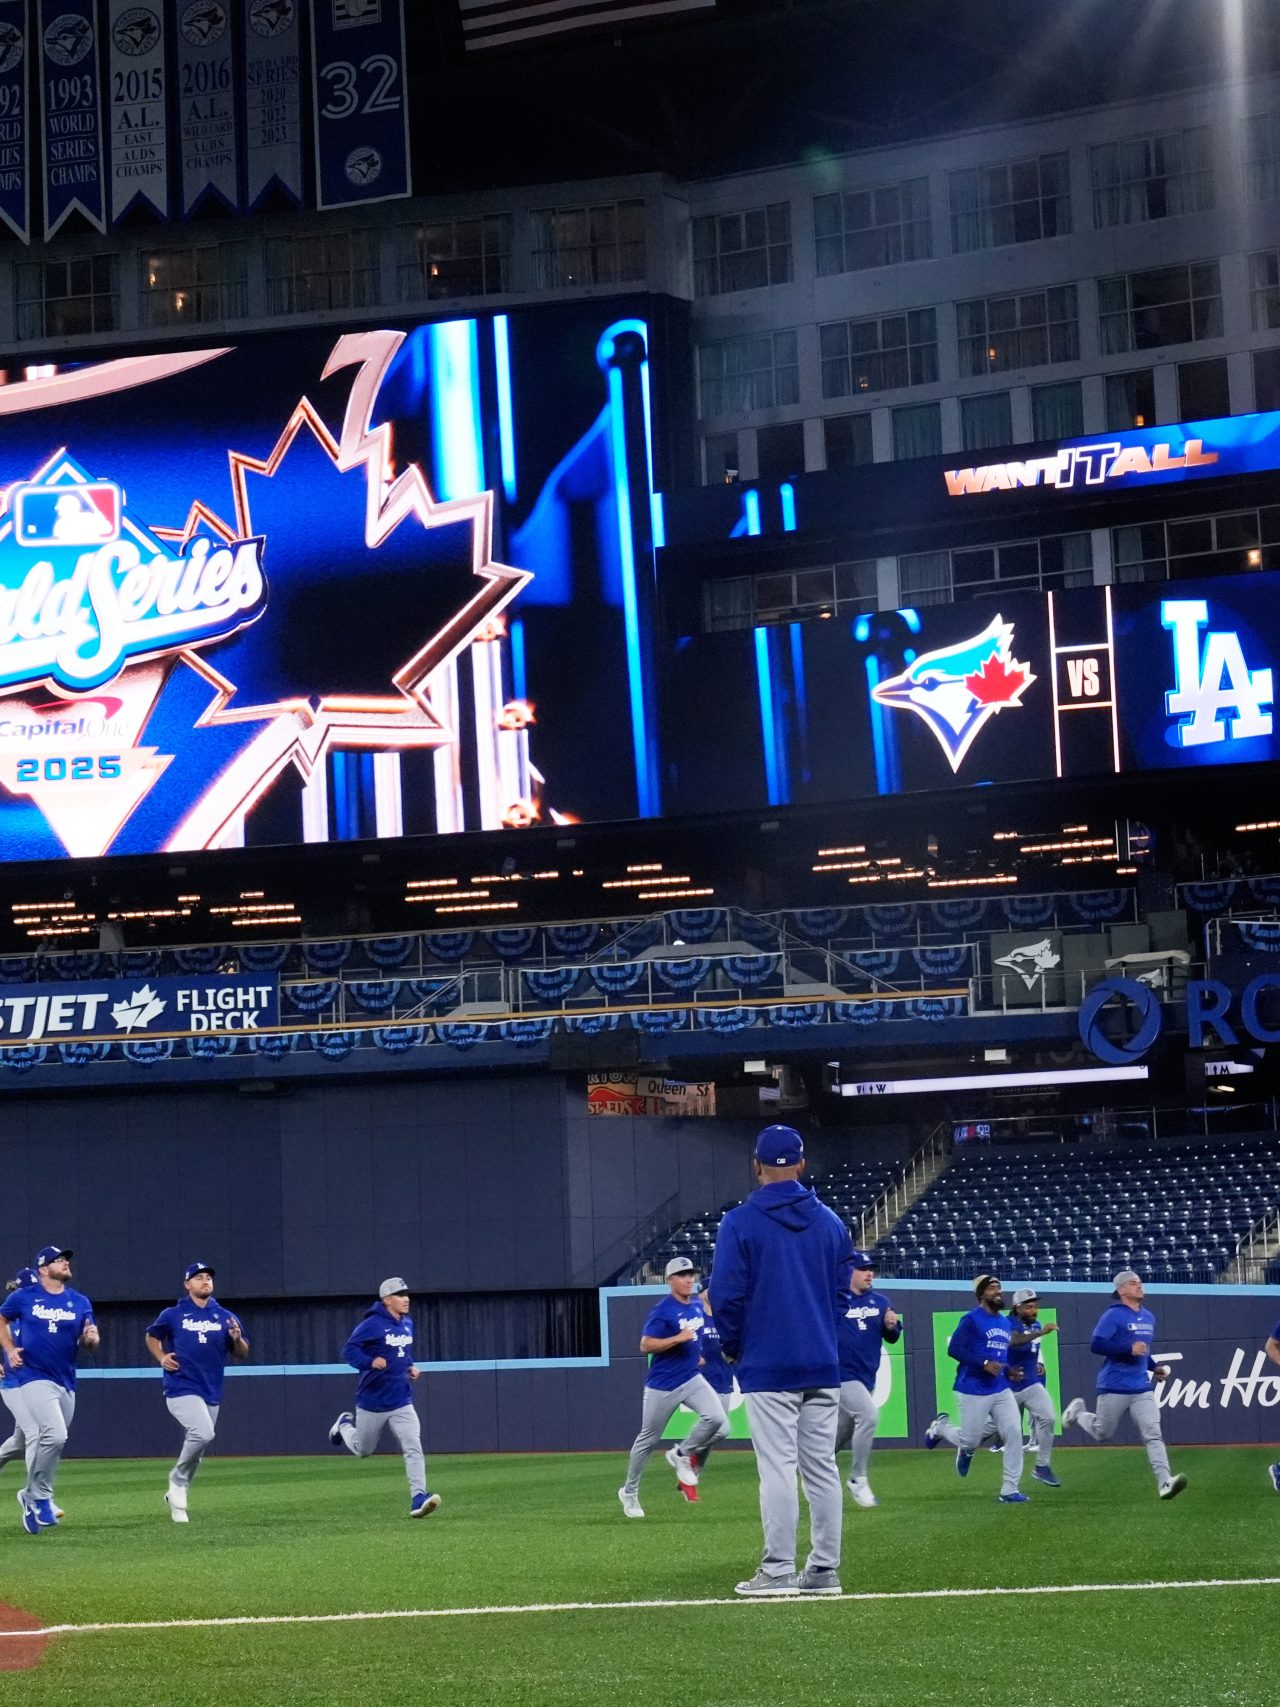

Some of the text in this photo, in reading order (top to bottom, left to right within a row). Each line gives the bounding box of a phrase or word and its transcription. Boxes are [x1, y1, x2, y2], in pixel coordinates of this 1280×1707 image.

[114, 68, 162, 102] 2015
[182, 57, 230, 94] 2016
[248, 66, 298, 86] SERIES
[320, 54, 401, 119] 32
[48, 74, 92, 111] 1993
[118, 107, 160, 129] A.L.
[188, 99, 228, 121] A.L.
[49, 113, 95, 135] WORLD
[124, 132, 153, 145] EAST
[50, 140, 95, 161] SERIES
[186, 154, 233, 169] CHAMPS
[50, 164, 98, 186] CHAMPS
[116, 163, 163, 178] CHAMPS
[944, 456, 1060, 496] WANT
[1106, 439, 1218, 477] ALL
[56, 540, 263, 678] Series
[1066, 658, 1100, 697] VS
[1161, 600, 1274, 748] LA
[16, 755, 122, 783] 2025
[177, 986, 273, 1012] FLIGHT
[190, 1010, 261, 1032] DECK
[648, 1080, 687, 1096] Queen
[696, 1084, 710, 1098] St
